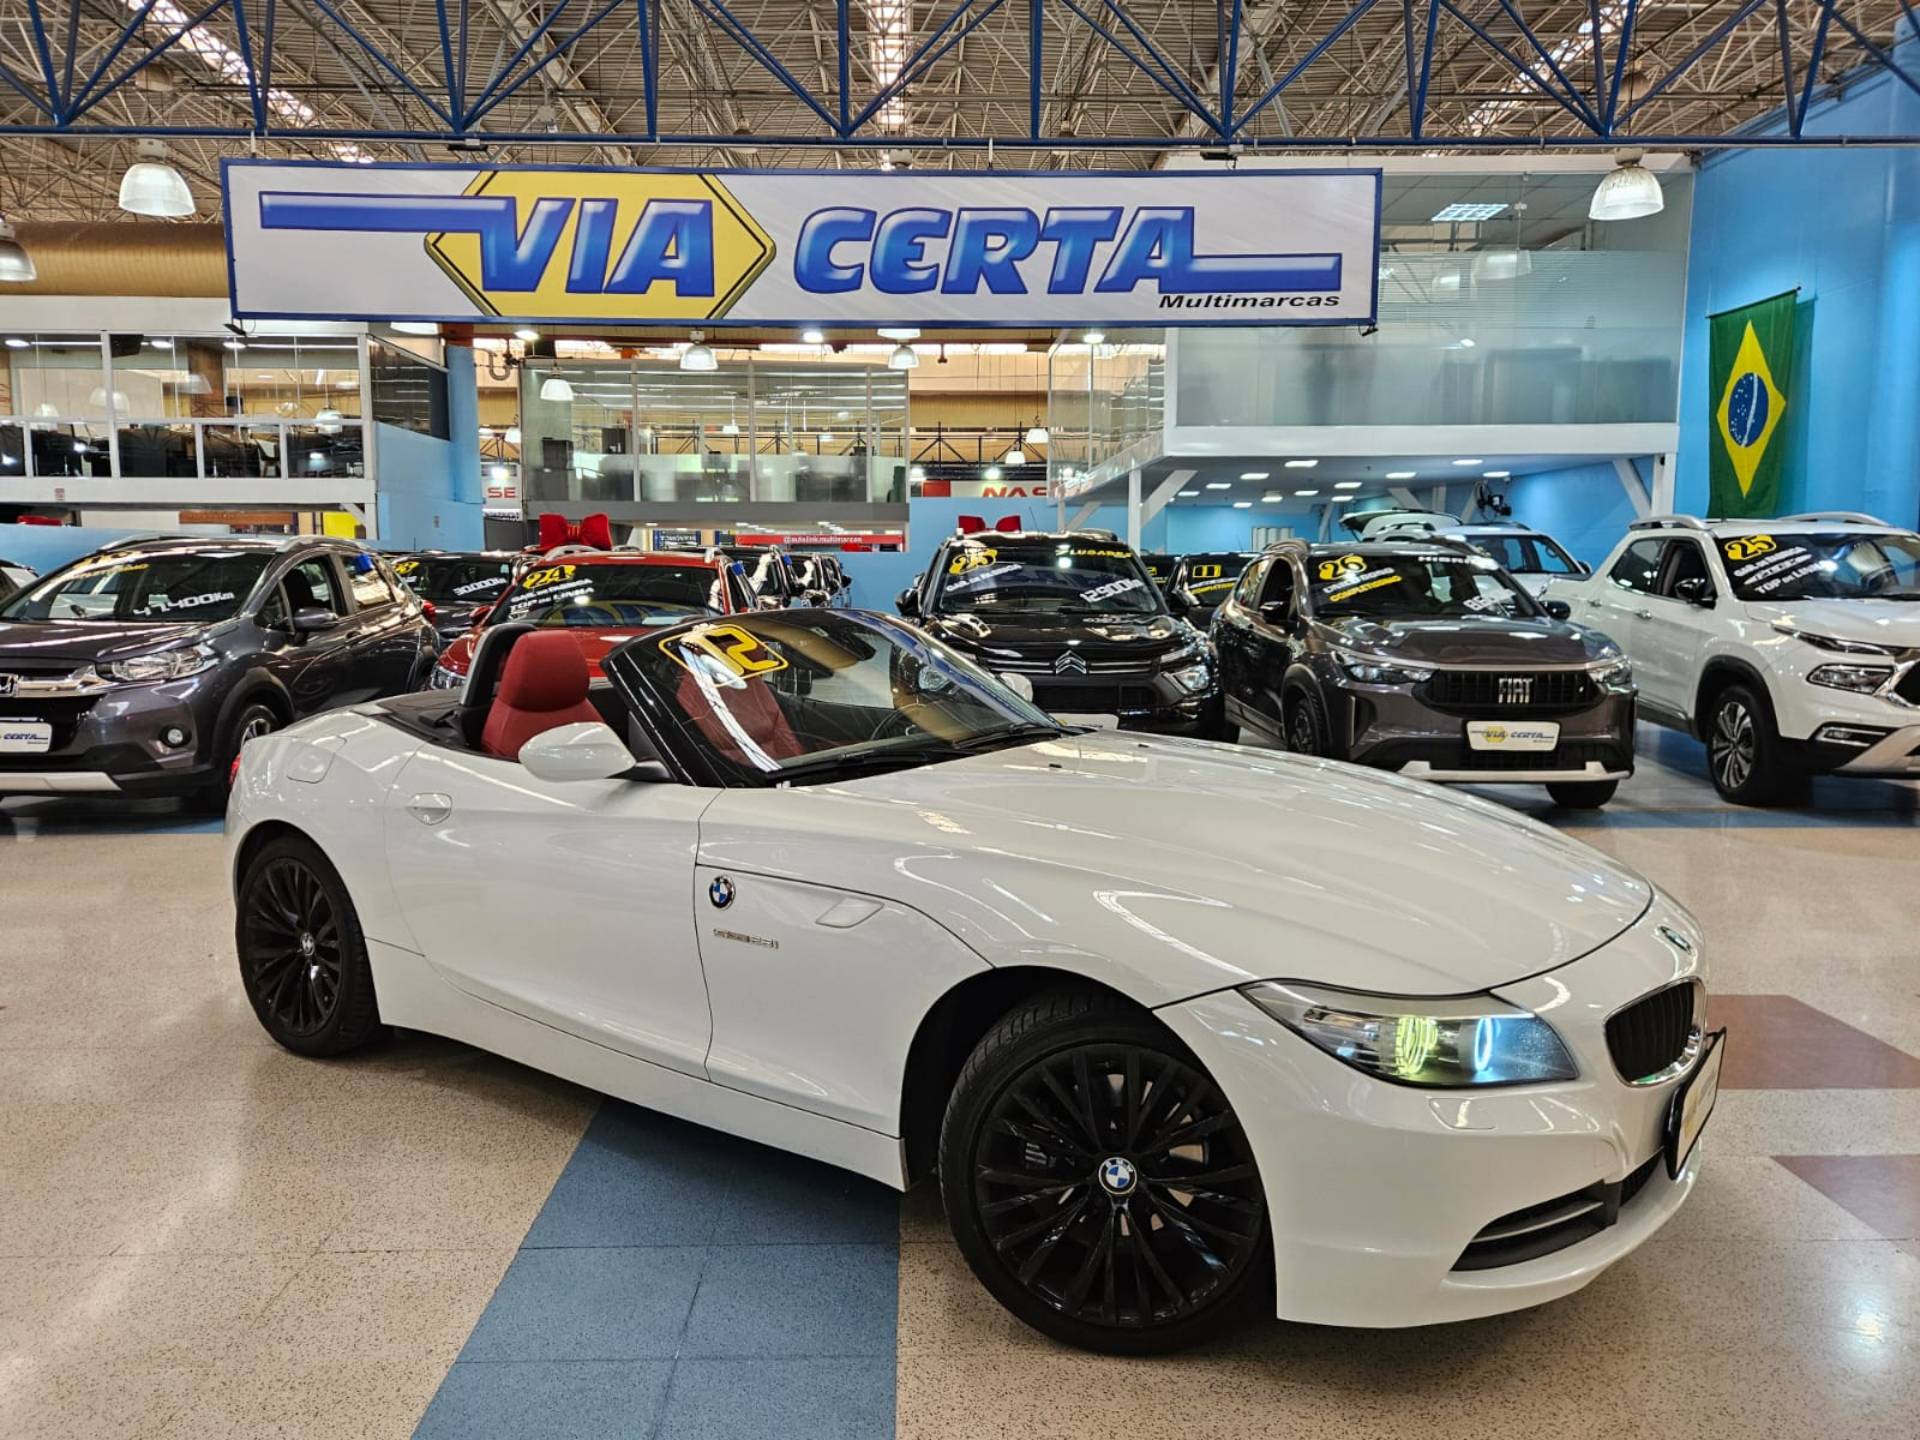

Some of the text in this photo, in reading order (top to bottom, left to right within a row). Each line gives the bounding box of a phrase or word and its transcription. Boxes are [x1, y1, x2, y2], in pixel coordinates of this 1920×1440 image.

[466, 195, 1194, 297] VIA CERTA
[1159, 293, 1341, 310] Multimarcas
[1725, 534, 1776, 560] 25
[1498, 677, 1533, 704] FIAT
